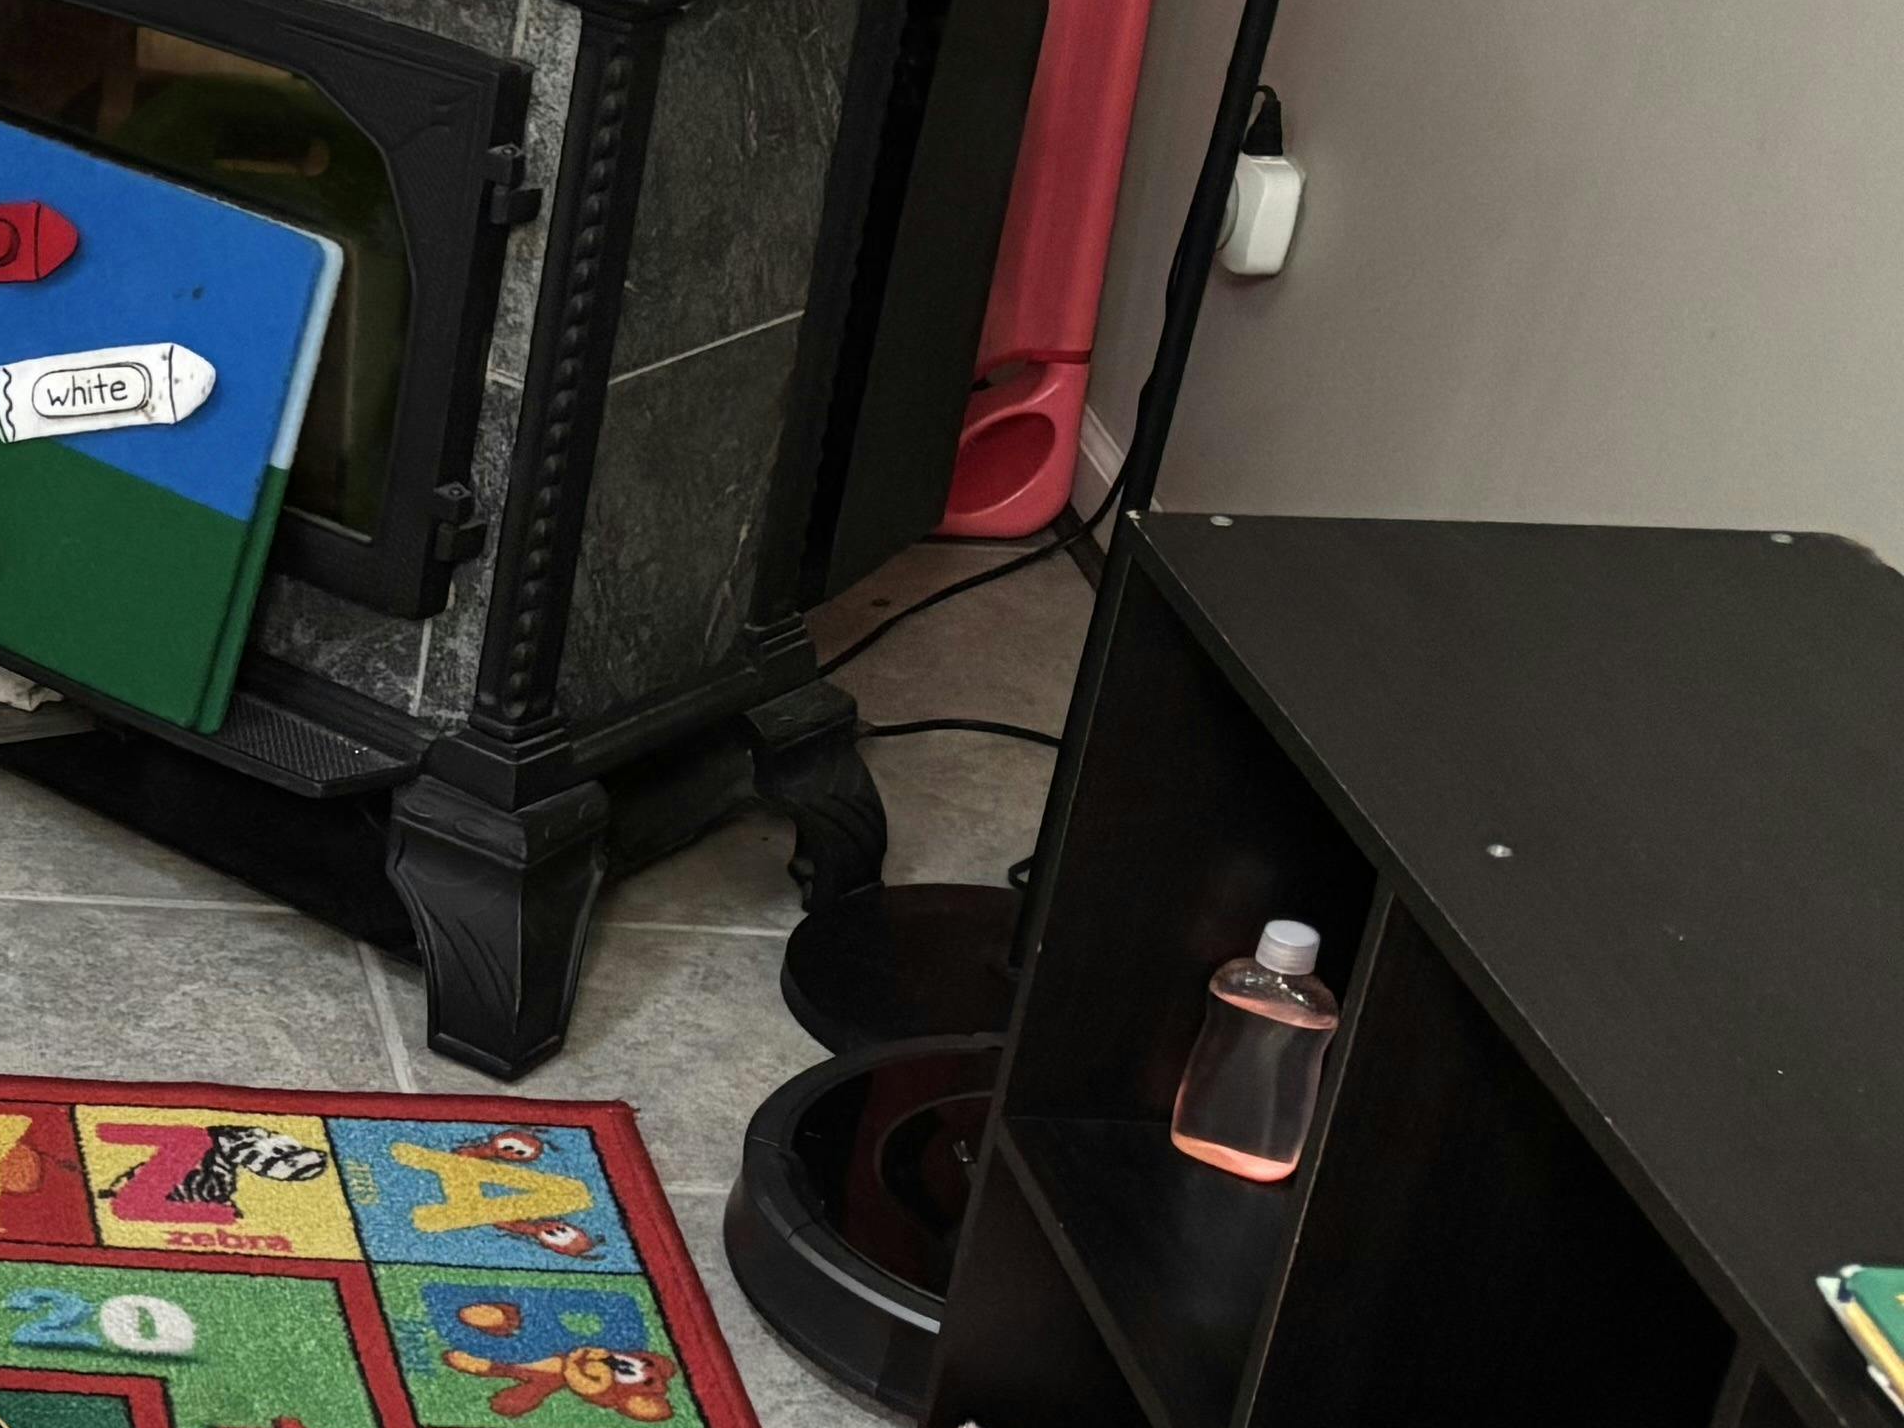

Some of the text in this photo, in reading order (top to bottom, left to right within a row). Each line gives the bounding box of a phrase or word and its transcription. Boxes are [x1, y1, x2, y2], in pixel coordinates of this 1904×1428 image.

[47, 363, 130, 407] white
[96, 1122, 240, 1225] Z
[390, 1142, 594, 1233] A
[164, 1229, 295, 1253] zebra
[2, 1286, 198, 1356] 20
